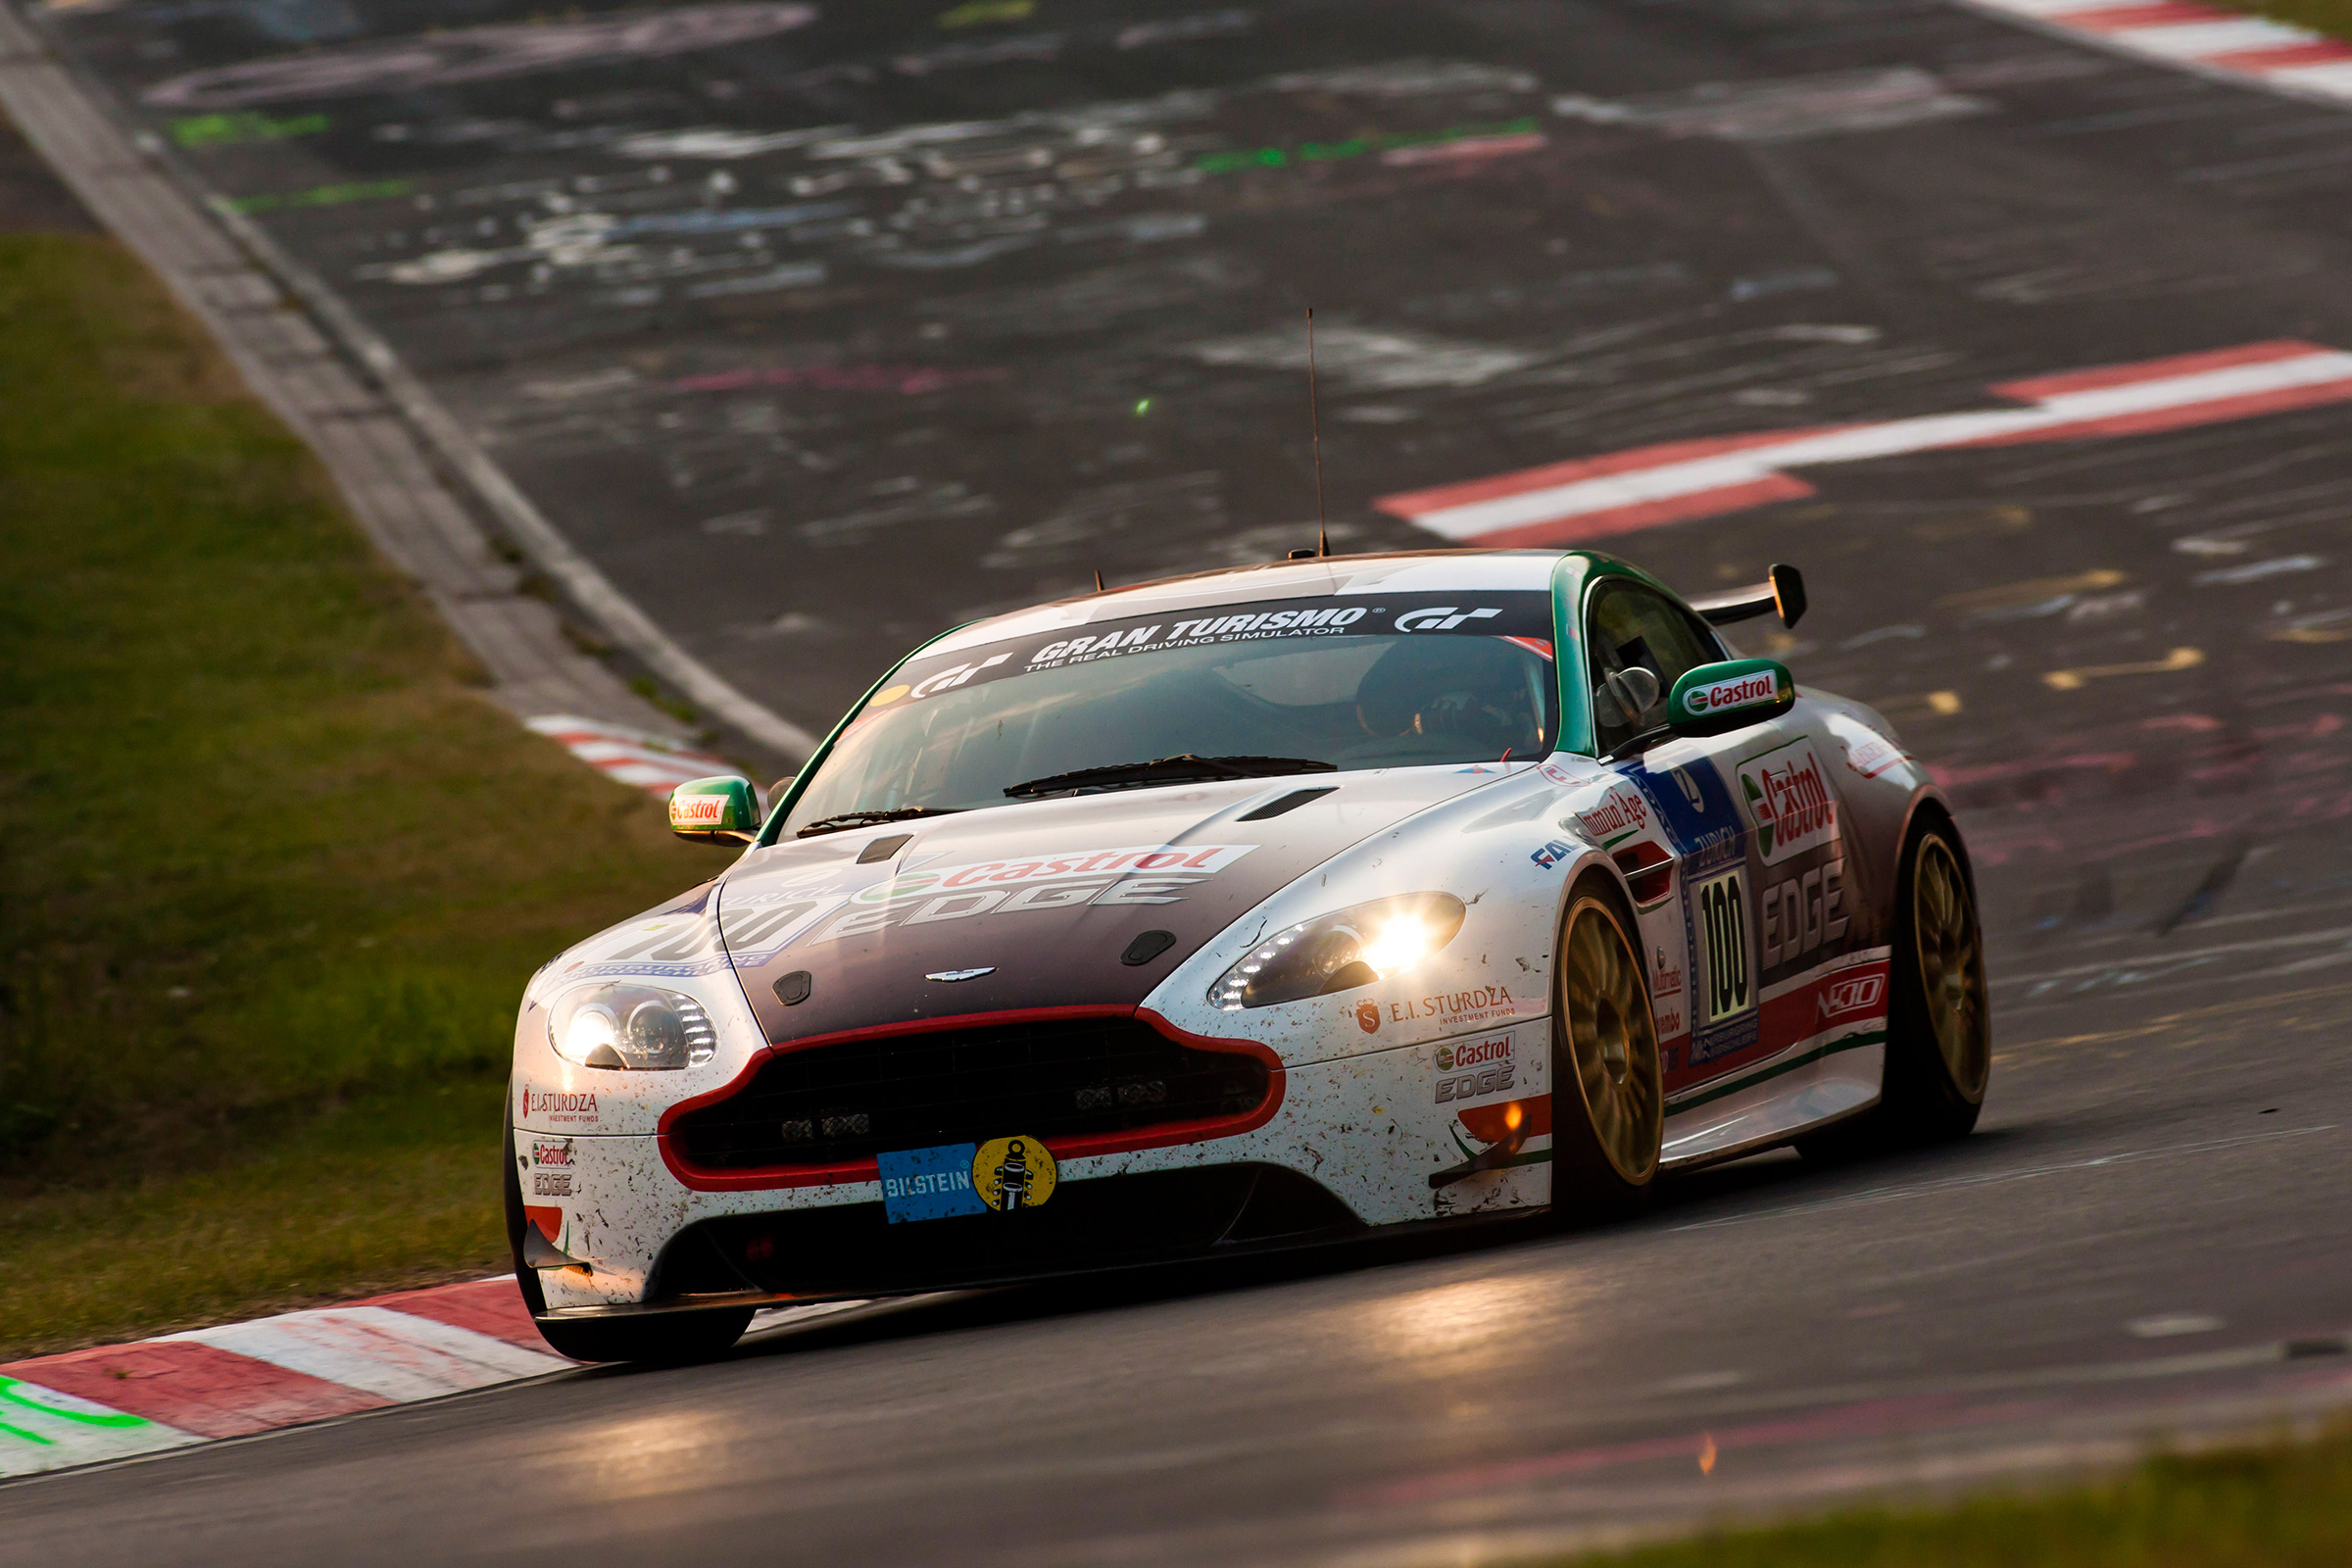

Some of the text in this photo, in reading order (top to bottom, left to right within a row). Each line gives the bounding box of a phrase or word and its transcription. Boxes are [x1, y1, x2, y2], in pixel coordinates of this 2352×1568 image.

[1024, 626, 1345, 673] THE REAL DRIVING SIMULATOR
[1031, 607, 1367, 663] GRAN TURISMO
[1710, 675, 1773, 707] Castrol
[677, 799, 720, 819] Castrol
[1762, 752, 1834, 848] Castrol
[942, 847, 1225, 888] Castrol
[605, 901, 818, 960] 100
[807, 877, 1214, 947] EDGE
[1762, 856, 1851, 970] EDGE
[1701, 875, 1748, 1016] 100
[1424, 986, 1513, 1017] STURDZA
[1440, 1007, 1516, 1025] INVESTMENT FUNDS
[1455, 1036, 1511, 1067] Castrol
[1435, 1065, 1516, 1103] EDGE
[534, 1173, 572, 1197] EDGE
[885, 1170, 970, 1198] BILSTEIN
